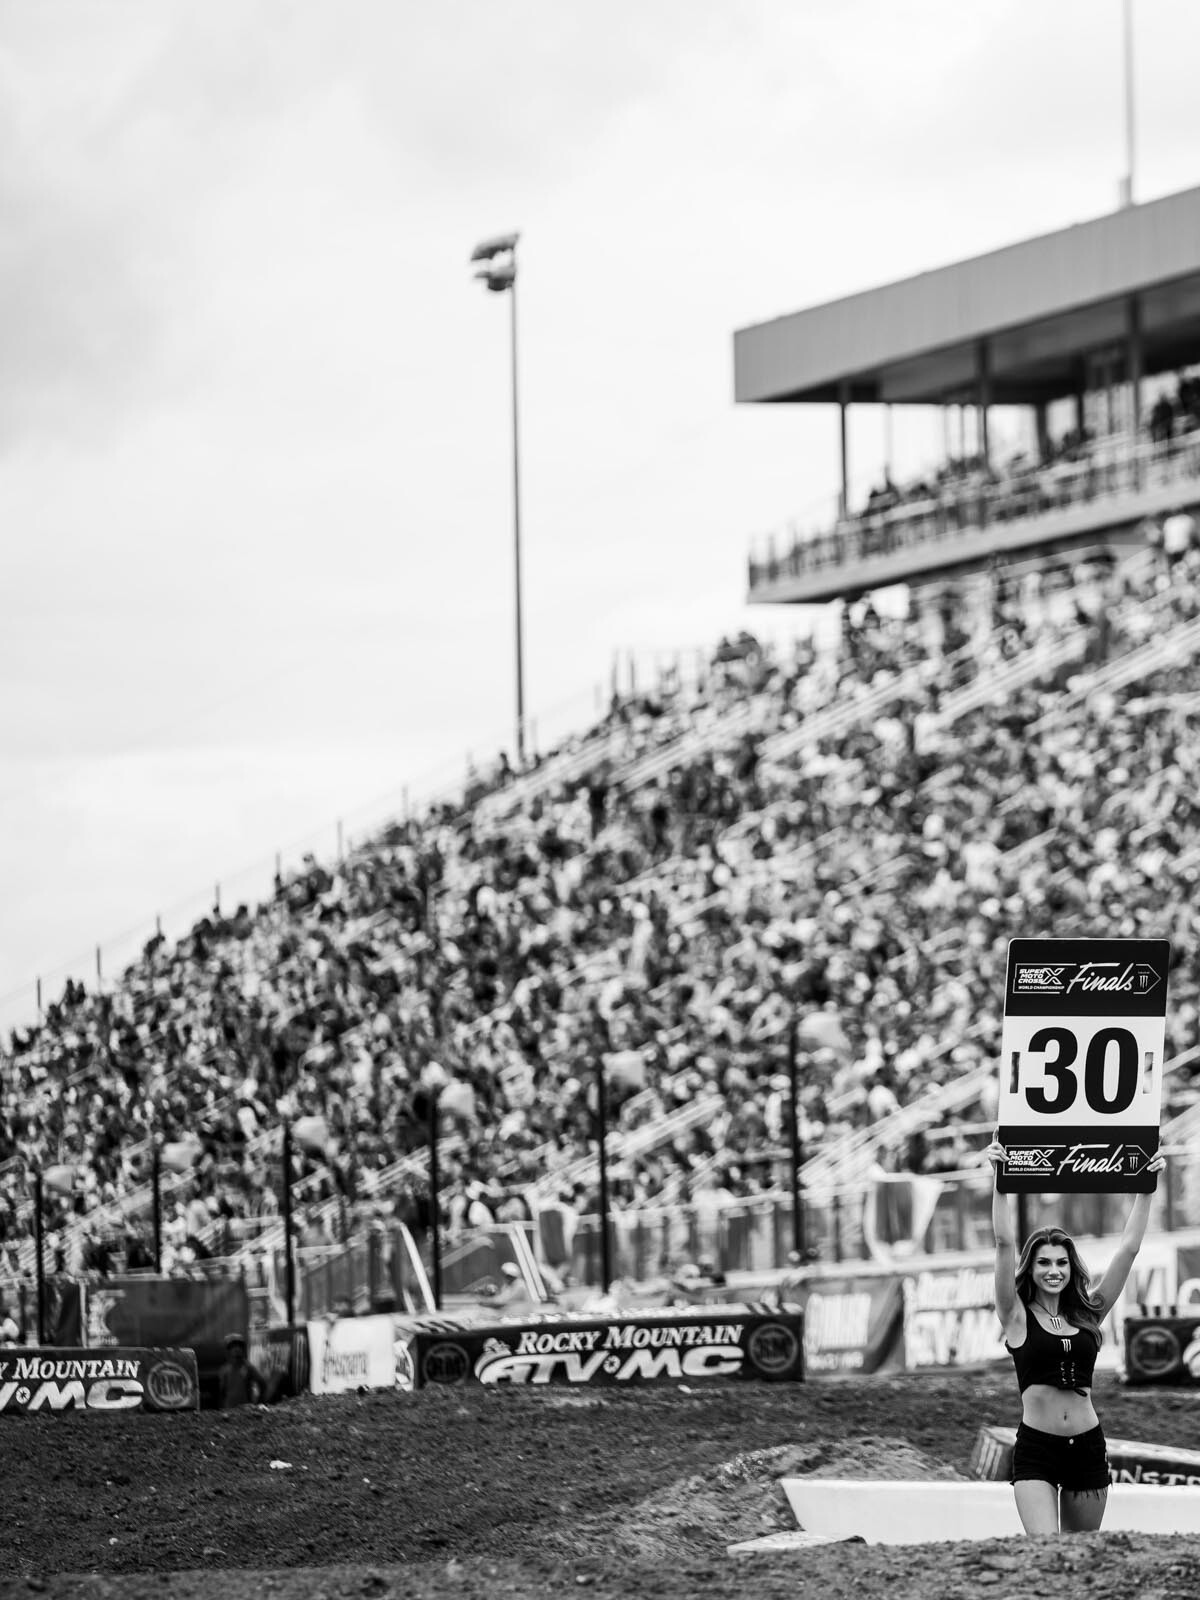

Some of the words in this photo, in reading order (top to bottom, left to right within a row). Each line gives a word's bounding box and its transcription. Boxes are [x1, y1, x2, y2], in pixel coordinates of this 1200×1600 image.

[1066, 962, 1135, 994] Finals
[1025, 1027, 1139, 1114] 30
[1056, 1143, 1125, 1176] Finals
[515, 1330, 600, 1355] ROCKY
[602, 1324, 744, 1351] MOUNTAIN
[12, 1357, 141, 1379] MOUNTAIN
